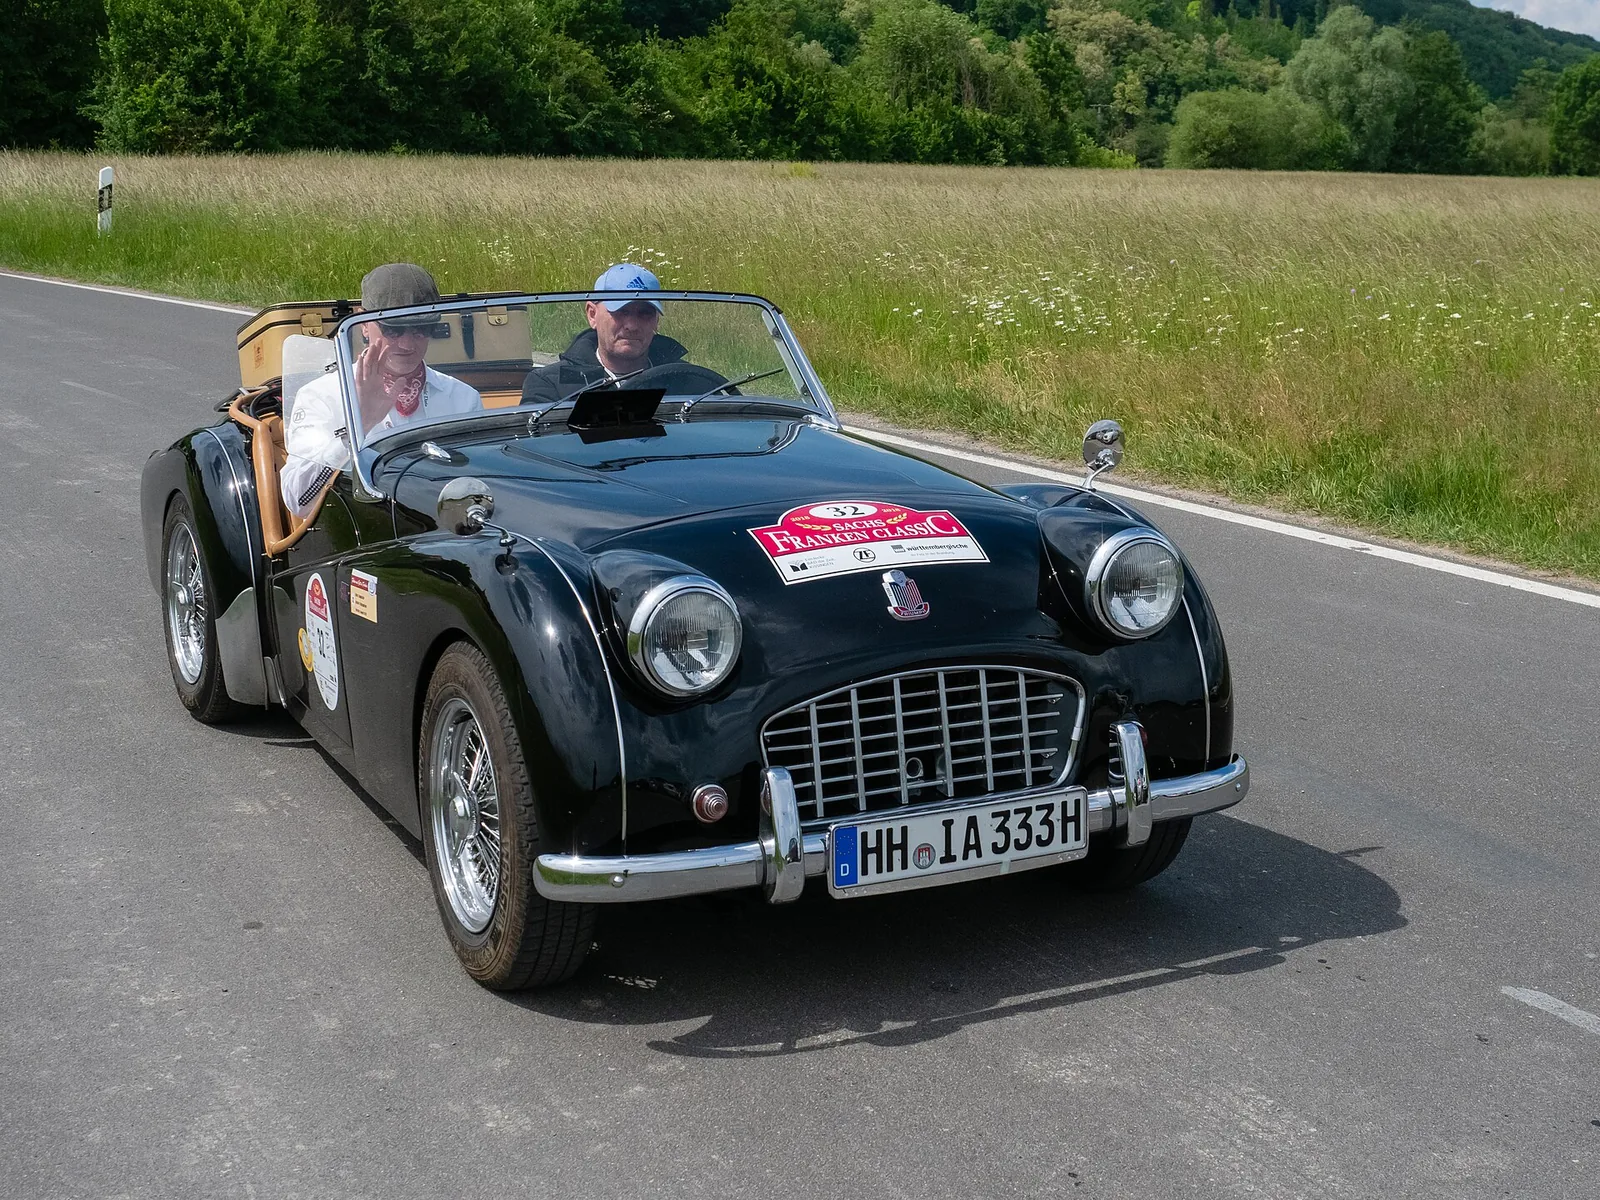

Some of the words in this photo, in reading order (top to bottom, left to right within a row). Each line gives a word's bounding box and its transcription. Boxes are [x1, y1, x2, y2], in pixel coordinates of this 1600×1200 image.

[293, 409, 305, 422] ZF
[827, 505, 865, 517] 32
[832, 519, 887, 531] SACHS
[763, 530, 870, 552] FRANKEN
[872, 515, 959, 539] CLASSIC
[906, 543, 968, 551] württembergische
[855, 548, 875, 561] ZF
[860, 825, 908, 876] HH
[939, 815, 983, 864] IA
[990, 798, 1081, 854] 333H
[840, 863, 849, 876] D
